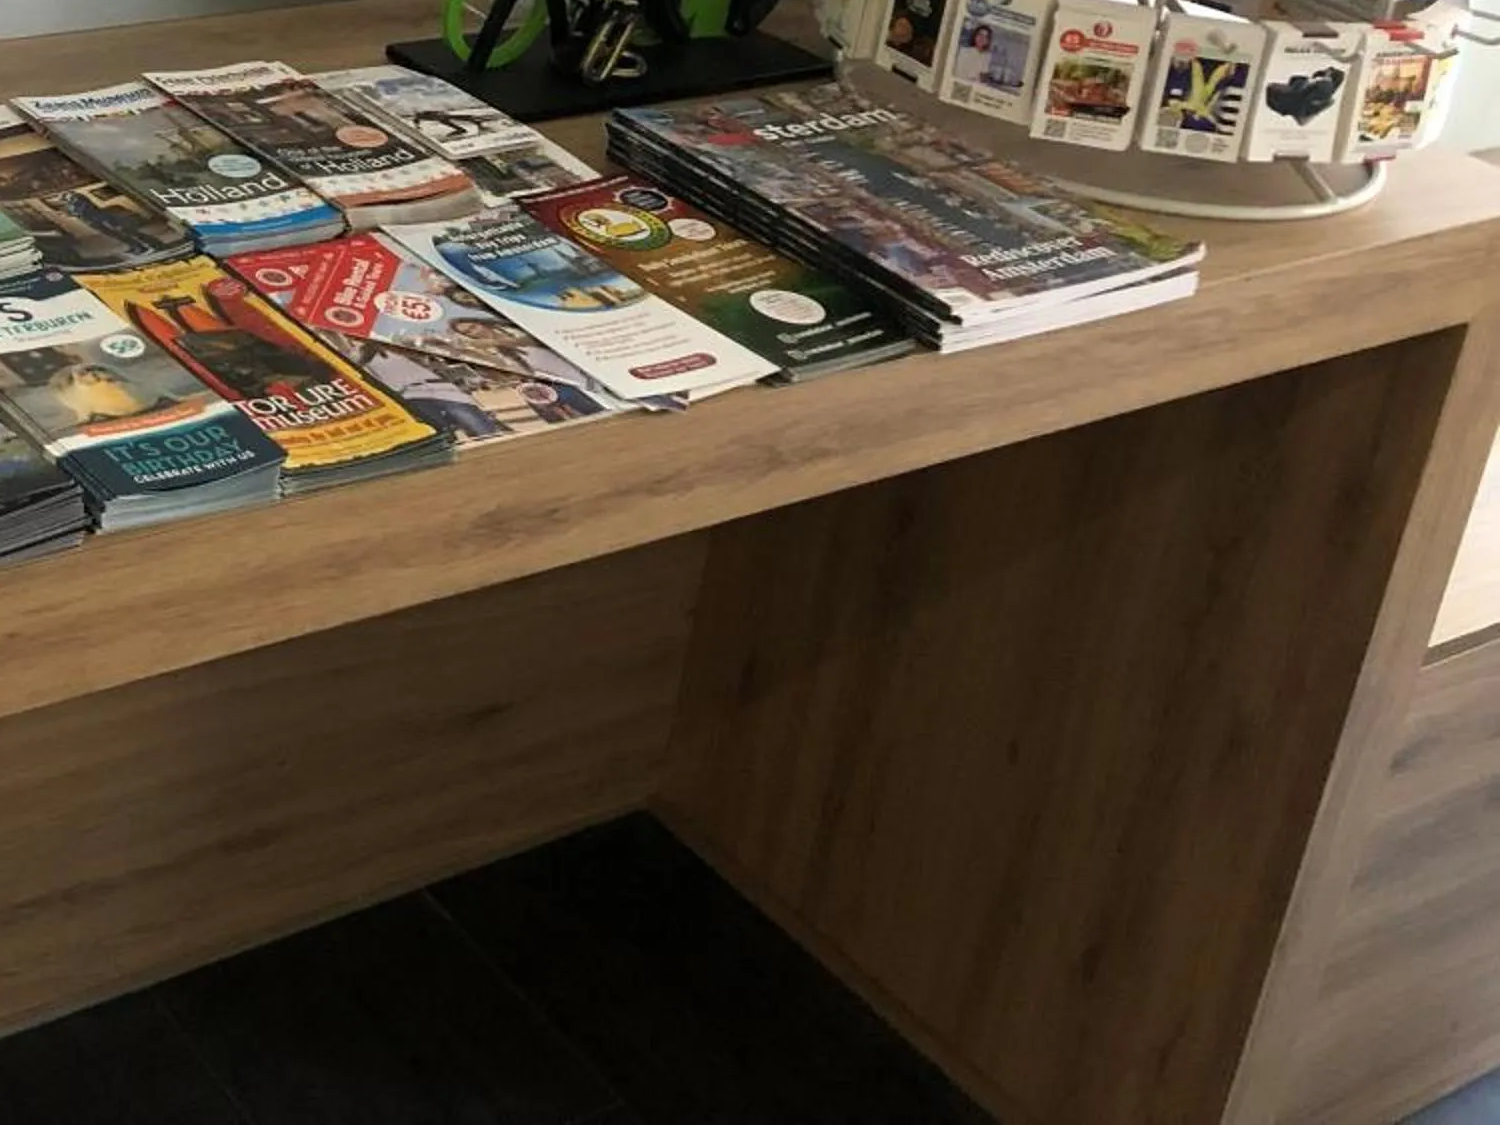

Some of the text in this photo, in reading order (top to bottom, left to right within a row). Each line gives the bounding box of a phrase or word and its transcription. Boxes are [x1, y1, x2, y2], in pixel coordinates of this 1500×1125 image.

[314, 148, 415, 175] Holland
[151, 171, 289, 206] Holland
[981, 246, 1119, 281] Amsterdam
[252, 393, 375, 432] museum
[102, 425, 229, 463] IT'S OUR
[120, 438, 243, 477] BIRTHDAY
[133, 450, 255, 484] CELEBRATE WITH US
